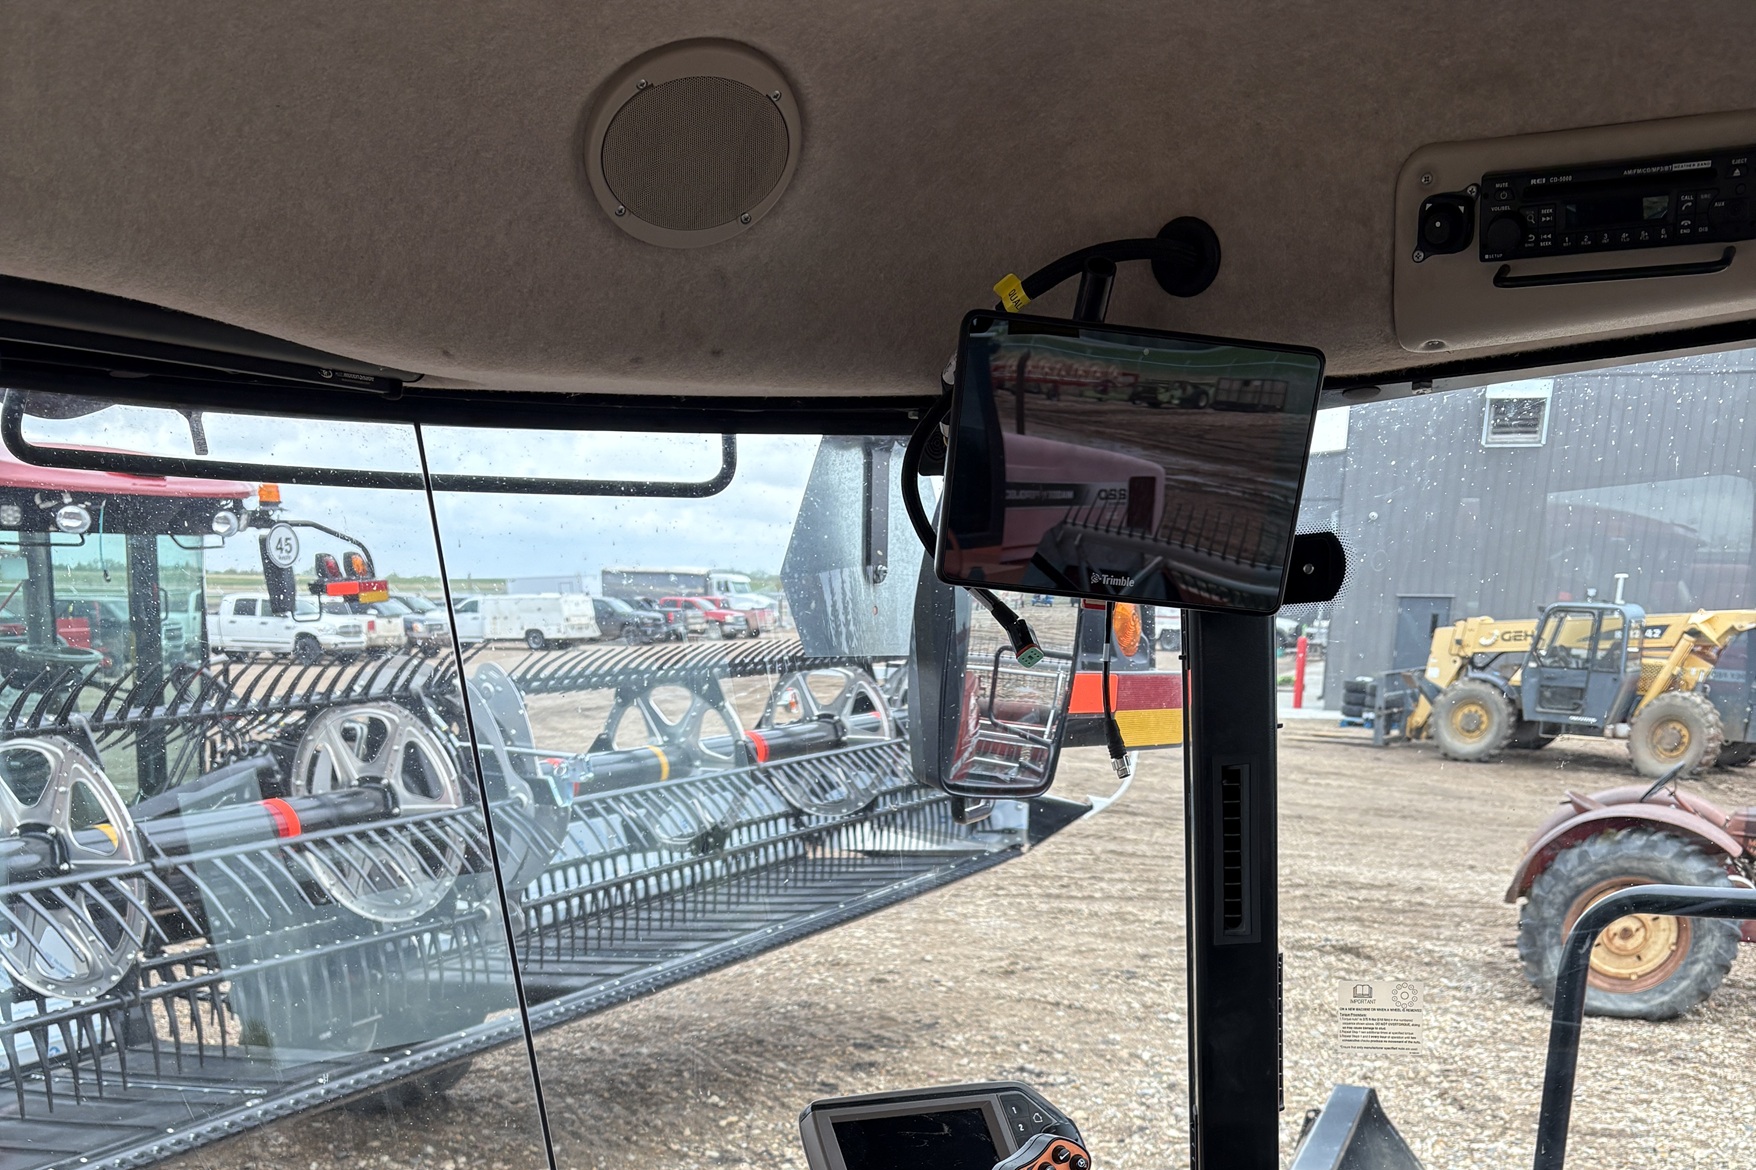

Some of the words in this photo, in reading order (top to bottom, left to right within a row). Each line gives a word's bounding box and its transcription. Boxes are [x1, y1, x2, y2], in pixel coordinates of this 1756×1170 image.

[1731, 157, 1748, 165] EJECT
[1008, 288, 1023, 310] QUAL
[276, 536, 293, 554] 45
[1101, 574, 1135, 587] Trimble
[1501, 630, 1541, 642] GEH
[1011, 1106, 1017, 1114] 1
[1018, 1123, 1025, 1132] 2
